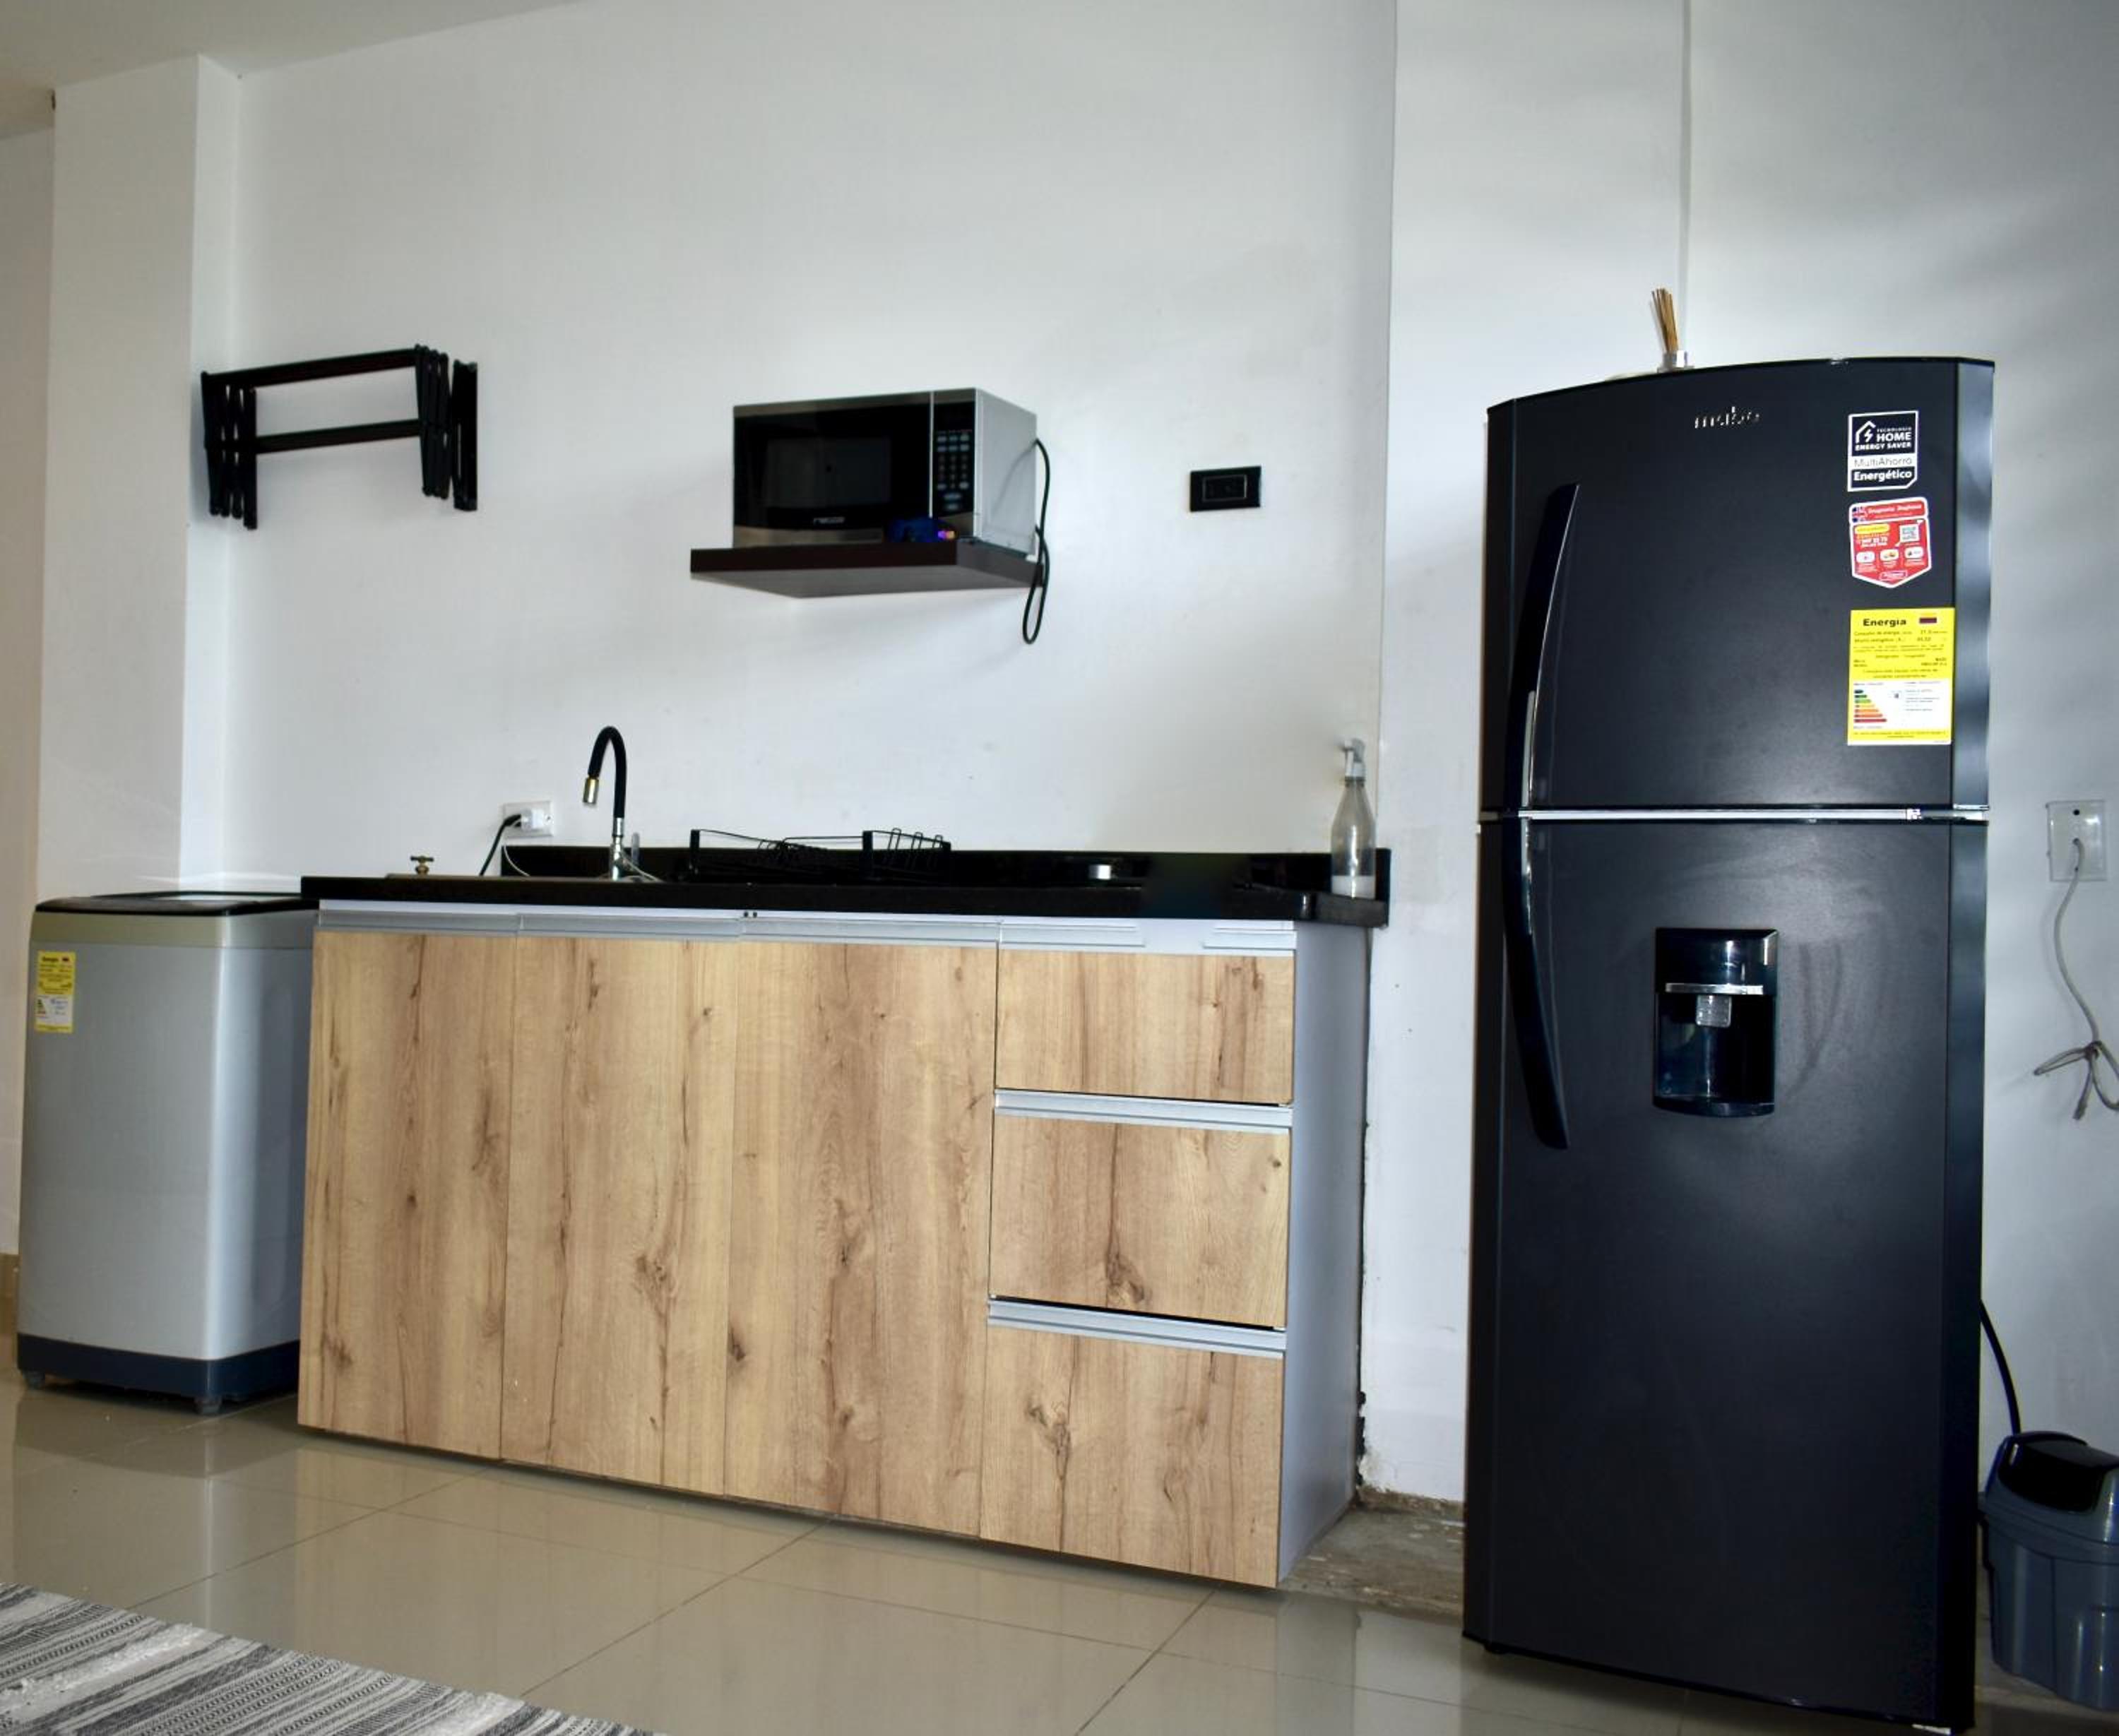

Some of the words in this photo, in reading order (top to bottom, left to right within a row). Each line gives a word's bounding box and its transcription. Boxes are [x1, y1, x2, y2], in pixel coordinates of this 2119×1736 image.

[1876, 432, 1912, 442] HOME
[1853, 457, 1913, 467] MultiAhorro
[1853, 469, 1913, 482] Energético
